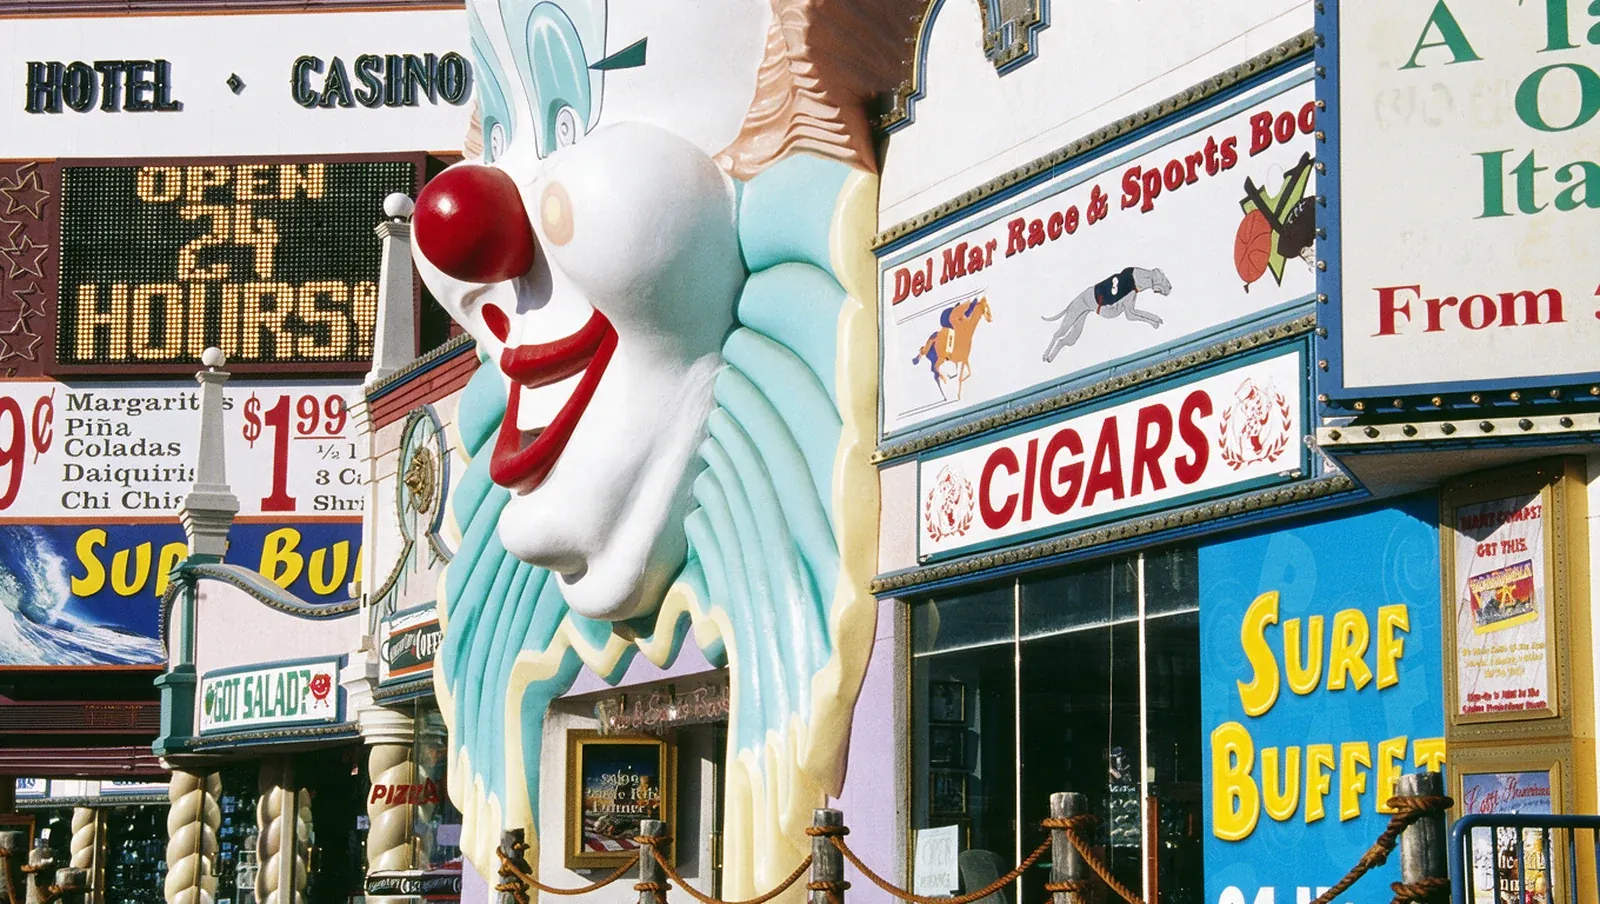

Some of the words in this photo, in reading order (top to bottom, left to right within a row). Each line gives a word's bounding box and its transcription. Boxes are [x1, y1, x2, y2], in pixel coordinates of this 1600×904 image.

[1397, 0, 1484, 70] A
[25, 60, 183, 114] HOTEL
[291, 51, 474, 107] CASINO
[137, 163, 325, 203] OPEN
[178, 203, 279, 280] 24
[892, 266, 932, 305] Del
[941, 237, 997, 284] Mar
[1005, 203, 1079, 258] Race
[1086, 184, 1109, 226] &
[1121, 135, 1237, 214] Sports
[1370, 284, 1567, 337] From
[64, 417, 132, 438] Piña
[65, 391, 234, 417] Margarits
[64, 437, 182, 458] Coladas
[978, 389, 1213, 531] CIGARS
[61, 491, 110, 510] Chi
[315, 469, 331, 486] 3
[1236, 590, 1410, 717] SURF
[213, 678, 241, 723] GOT
[243, 669, 311, 719] SALAD?
[370, 777, 440, 806] PIZZA
